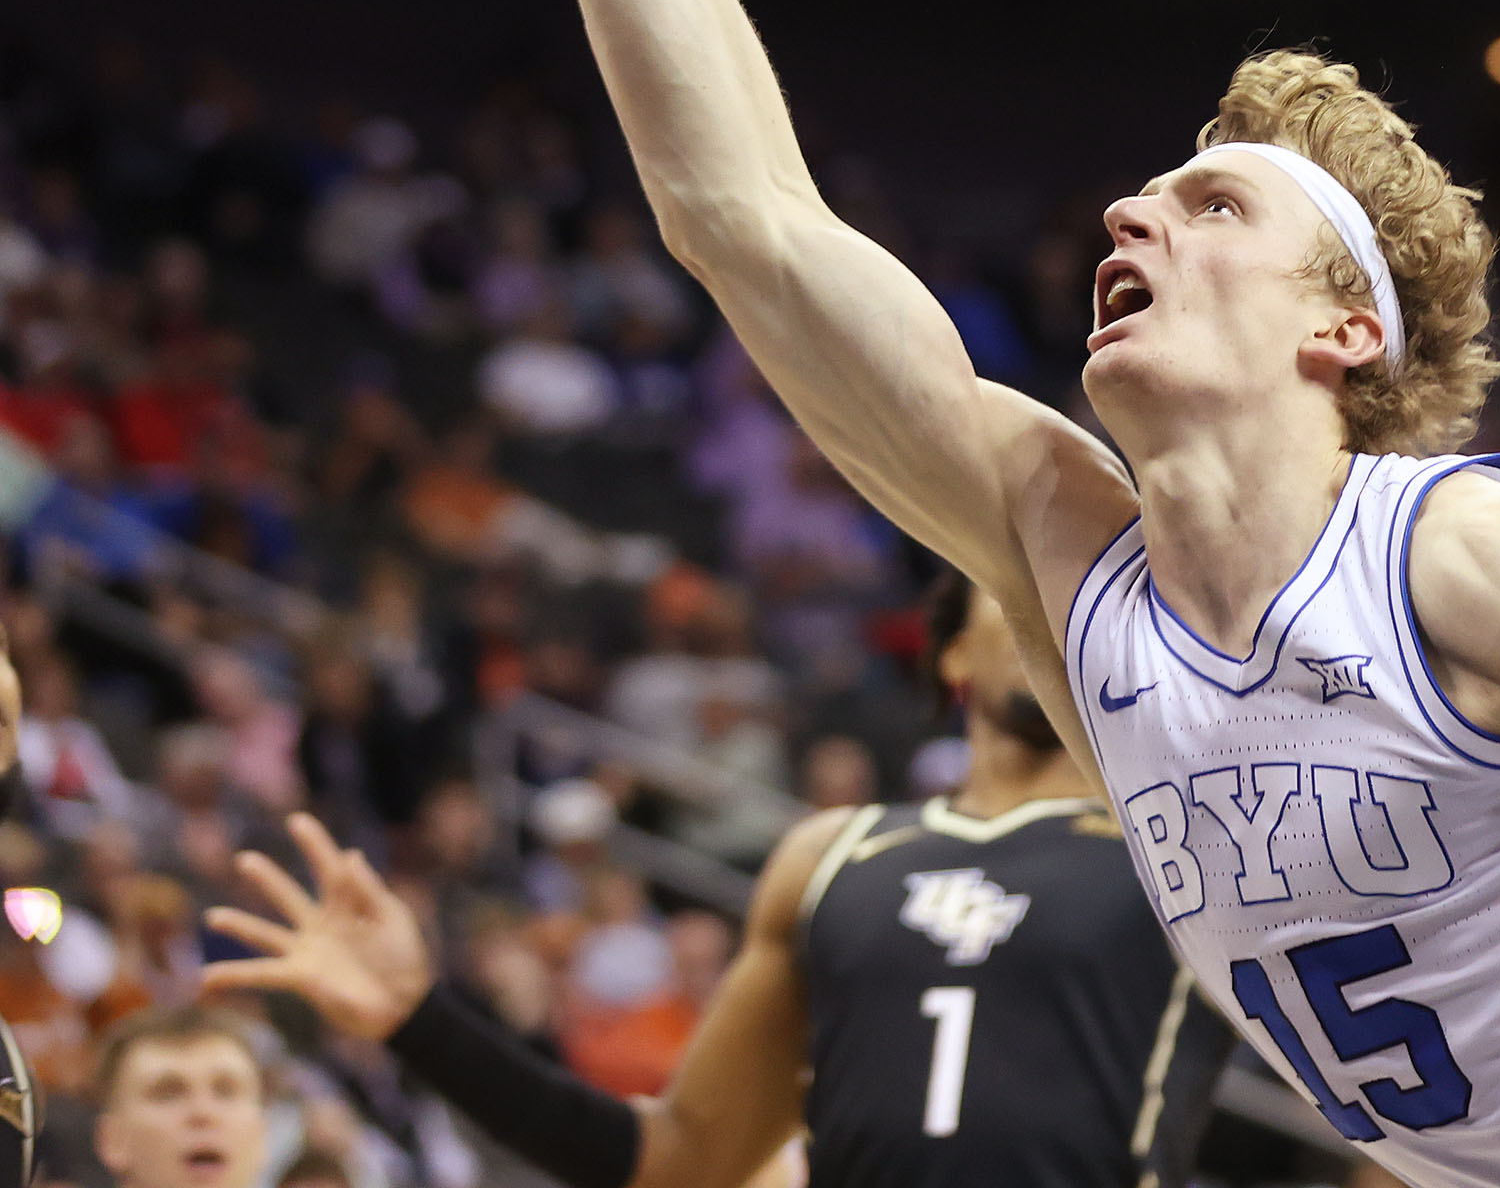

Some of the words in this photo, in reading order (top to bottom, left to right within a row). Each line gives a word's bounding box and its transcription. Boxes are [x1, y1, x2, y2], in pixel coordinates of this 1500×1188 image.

[1124, 762, 1455, 925] BYU
[920, 985, 977, 1139] 1
[1229, 922, 1474, 1144] 15
